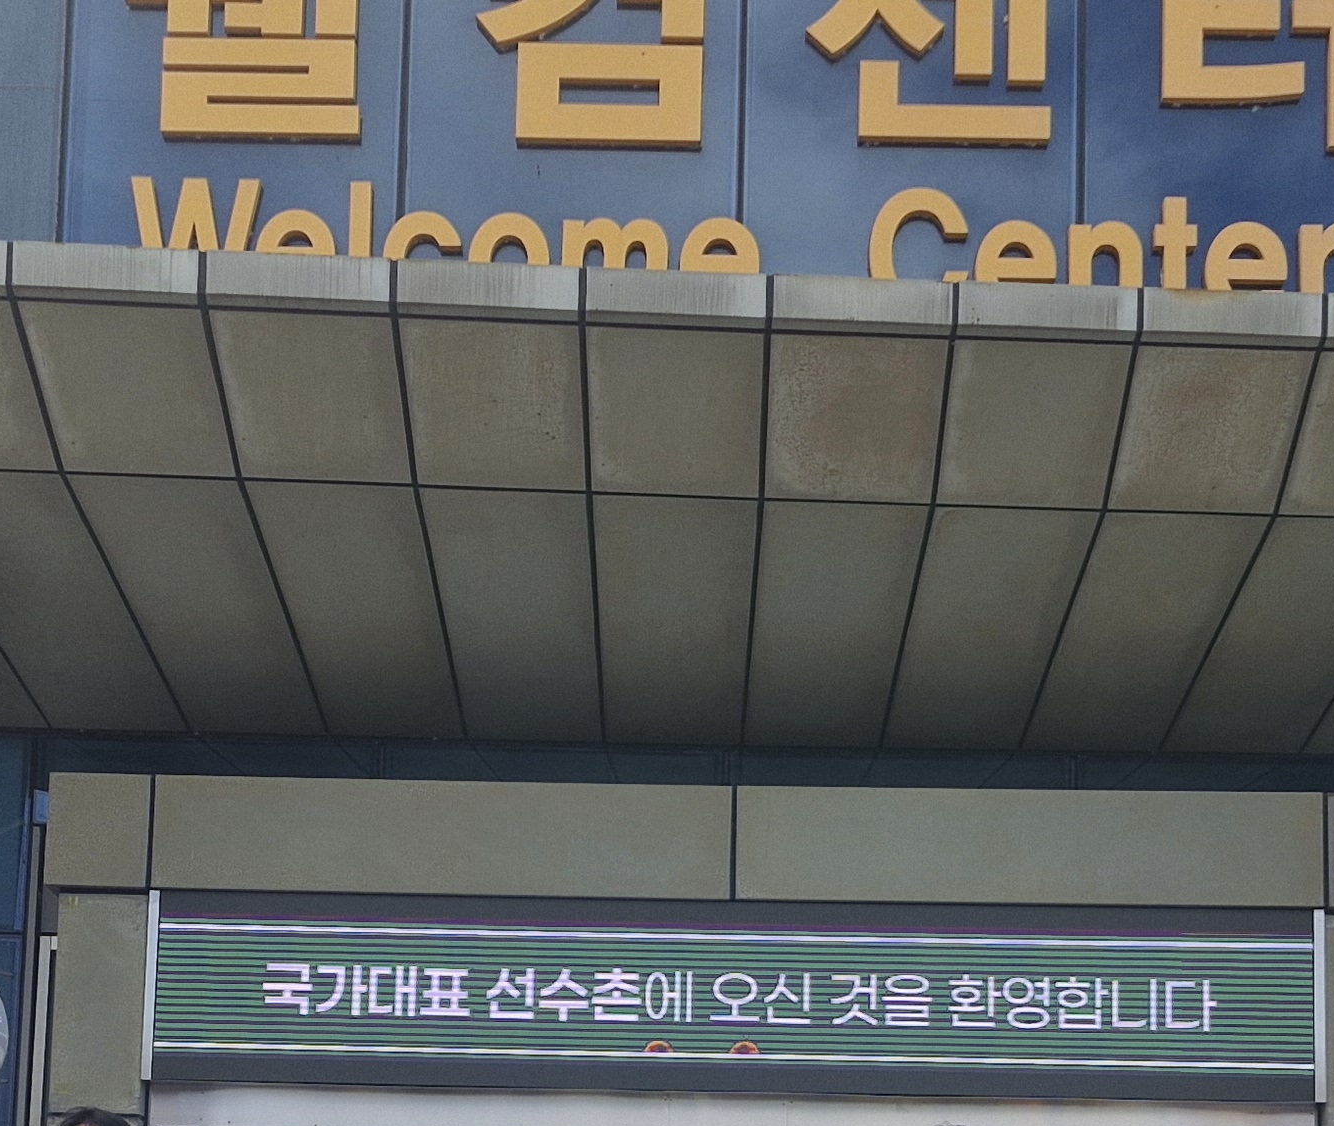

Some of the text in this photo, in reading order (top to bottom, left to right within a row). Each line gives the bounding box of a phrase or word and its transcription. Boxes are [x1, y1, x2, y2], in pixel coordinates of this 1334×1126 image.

[130, 176, 760, 275] Welcome
[263, 962, 1218, 1033] 국가대표 선수촌에 오신 것을 환영합니다
